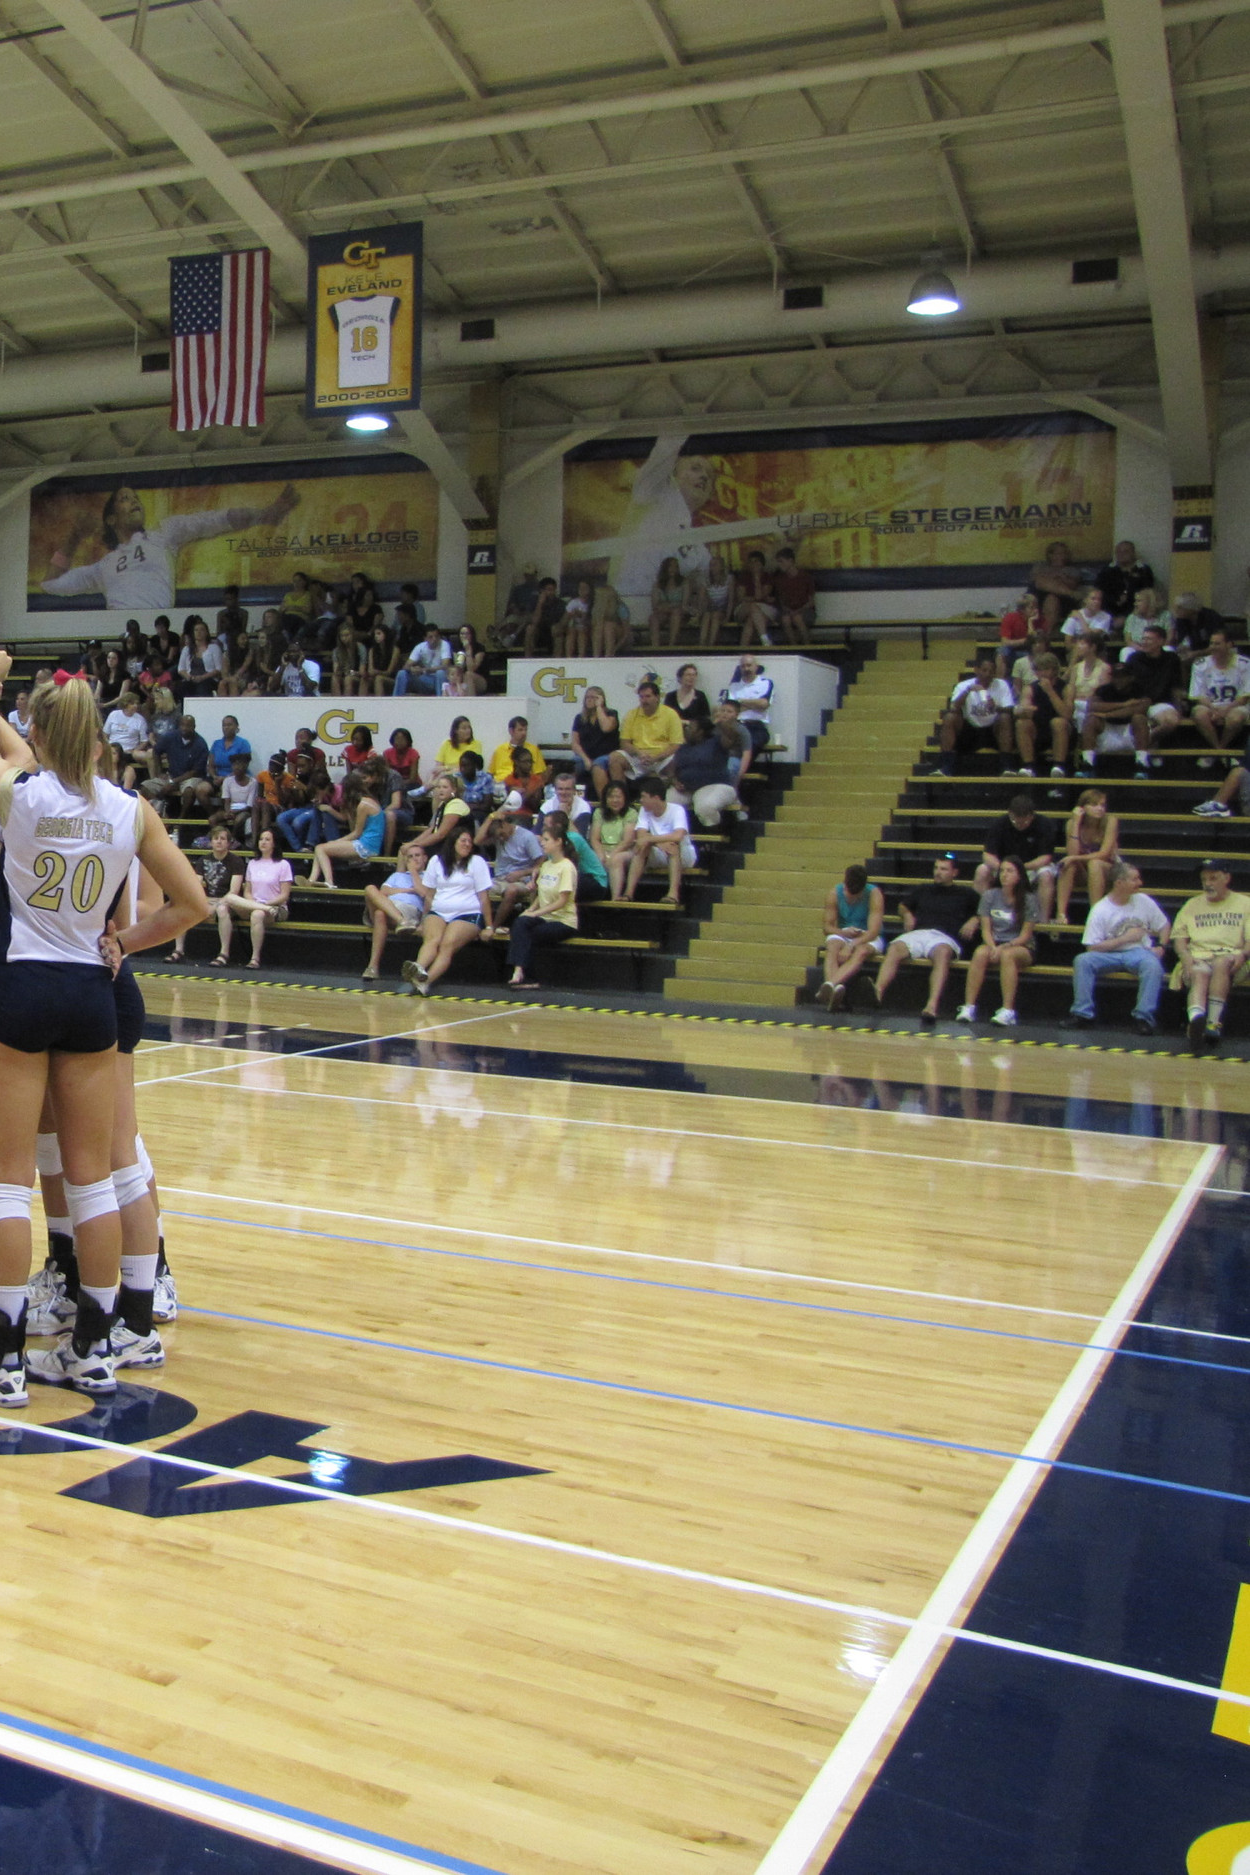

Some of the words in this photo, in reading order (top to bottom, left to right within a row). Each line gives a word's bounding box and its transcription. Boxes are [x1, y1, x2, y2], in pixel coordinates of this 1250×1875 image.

[342, 240, 386, 269] GT
[326, 279, 402, 295] EVELAND
[345, 272, 383, 284] KELE
[350, 325, 379, 353] 16
[316, 387, 409, 403] 2000-2003
[776, 511, 882, 529] ULRIKE
[889, 502, 1092, 524] STEGEMANN
[970, 518, 1092, 532] ALL-AMERICAN
[226, 535, 302, 551] TALISA
[309, 530, 420, 547] KELLOGG
[116, 545, 147, 573] 24
[530, 666, 588, 703] GT
[33, 816, 84, 839] GEORGIA
[85, 819, 114, 845] TECH
[26, 850, 105, 914] 20
